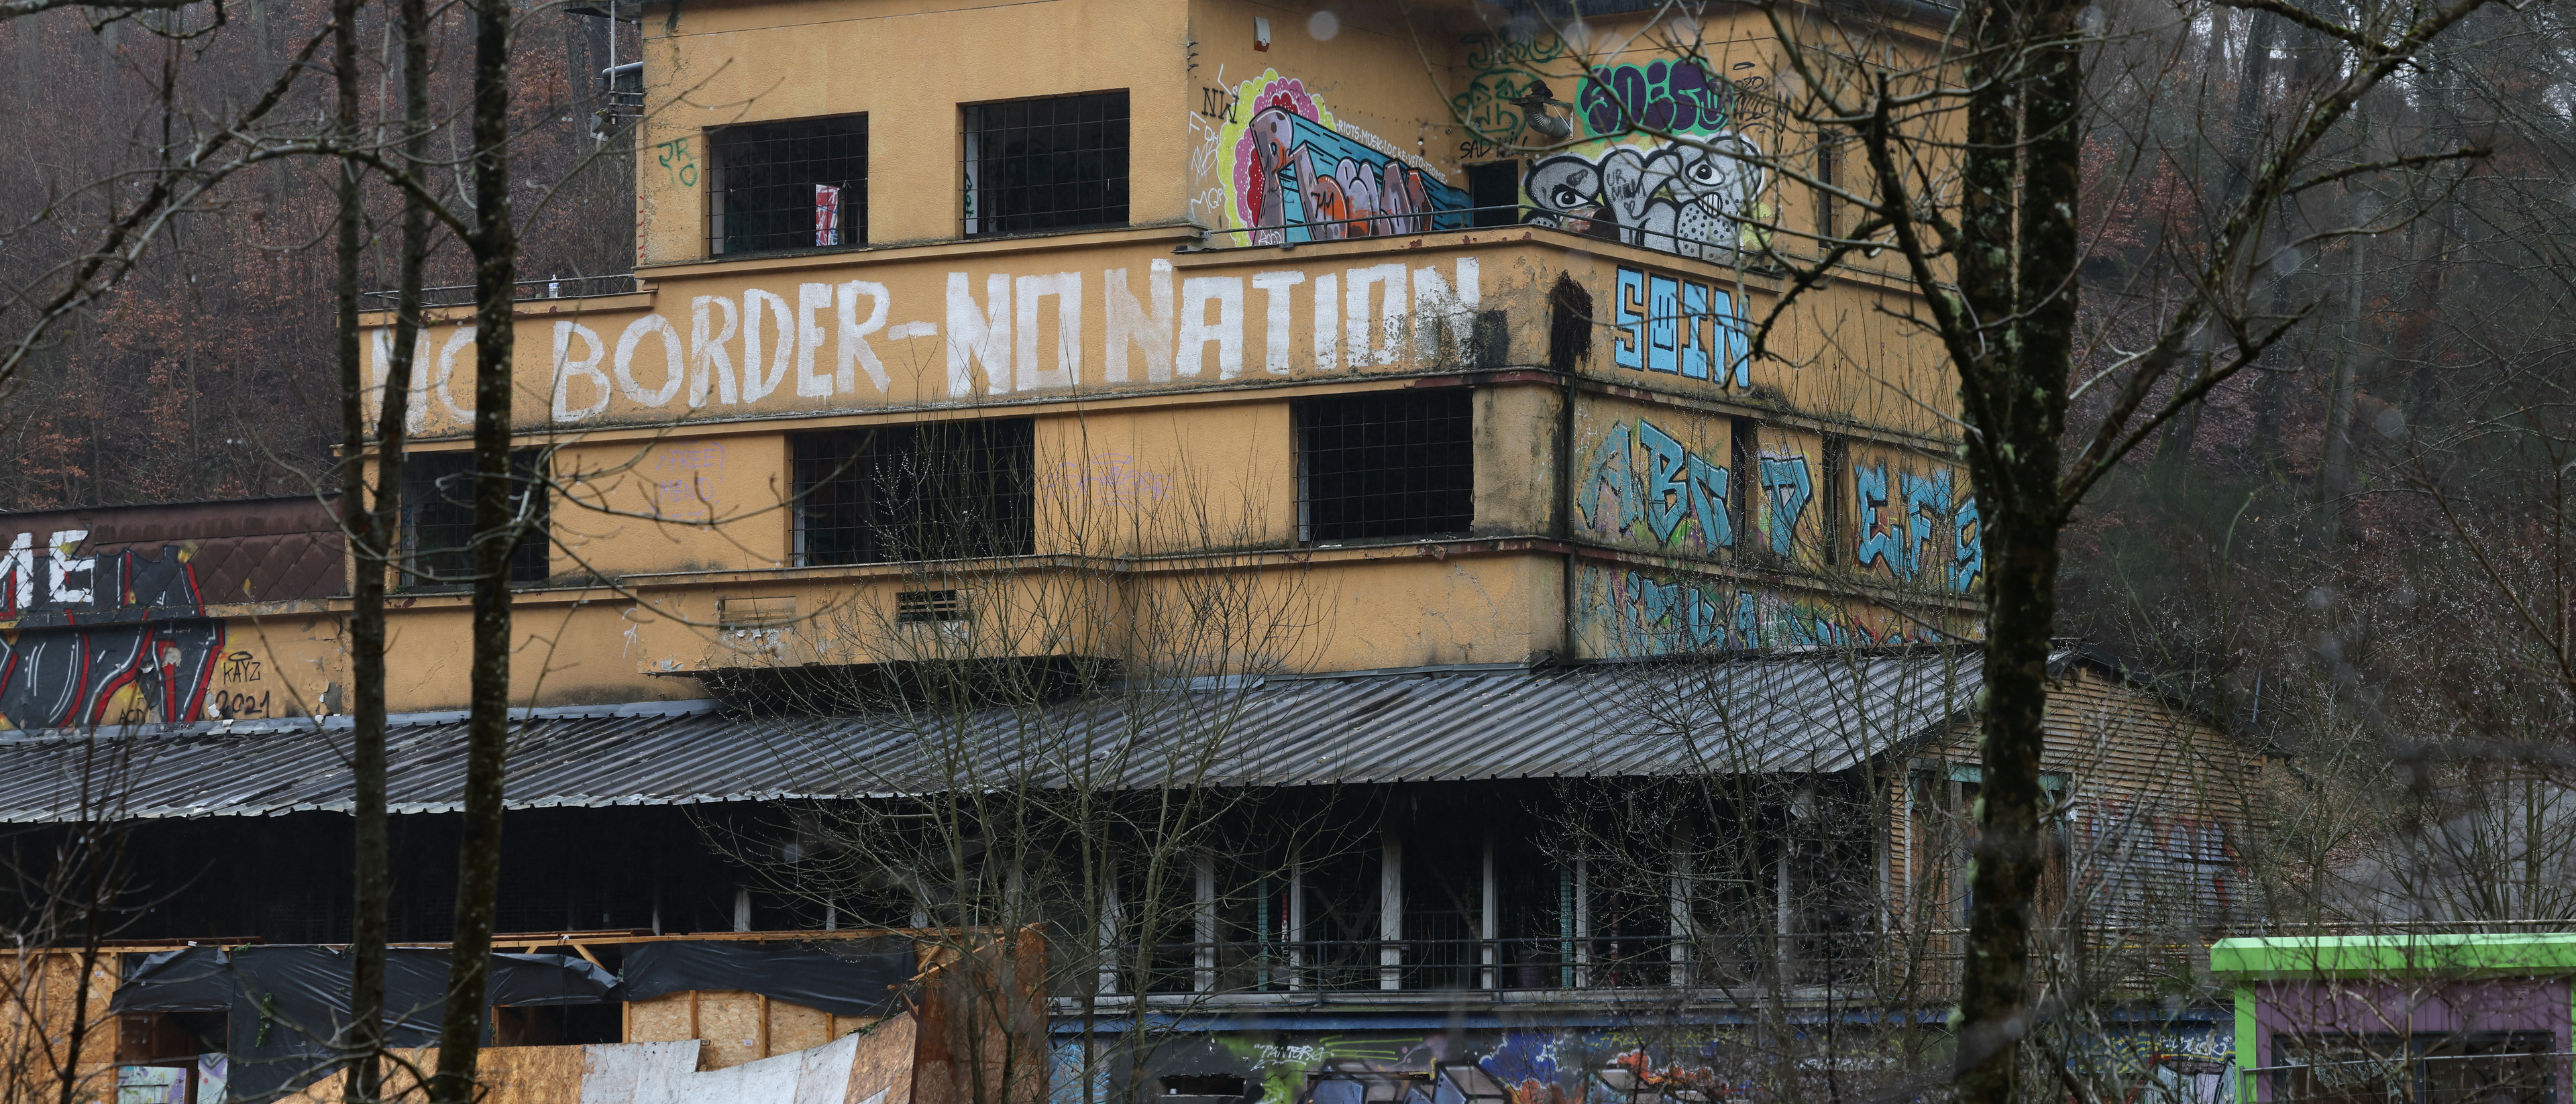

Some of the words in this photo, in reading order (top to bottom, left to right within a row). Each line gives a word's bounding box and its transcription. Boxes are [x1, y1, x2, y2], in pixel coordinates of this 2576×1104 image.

[1338, 119, 1360, 140] RIOTS
[1384, 140, 1407, 161] LOCKE
[1407, 154, 1424, 168] VETO
[1425, 161, 1447, 184] TEOME
[1460, 139, 1492, 159] SAD
[1104, 257, 1480, 383] NATION
[668, 448, 717, 474] FREE
[215, 689, 271, 719] 2021
